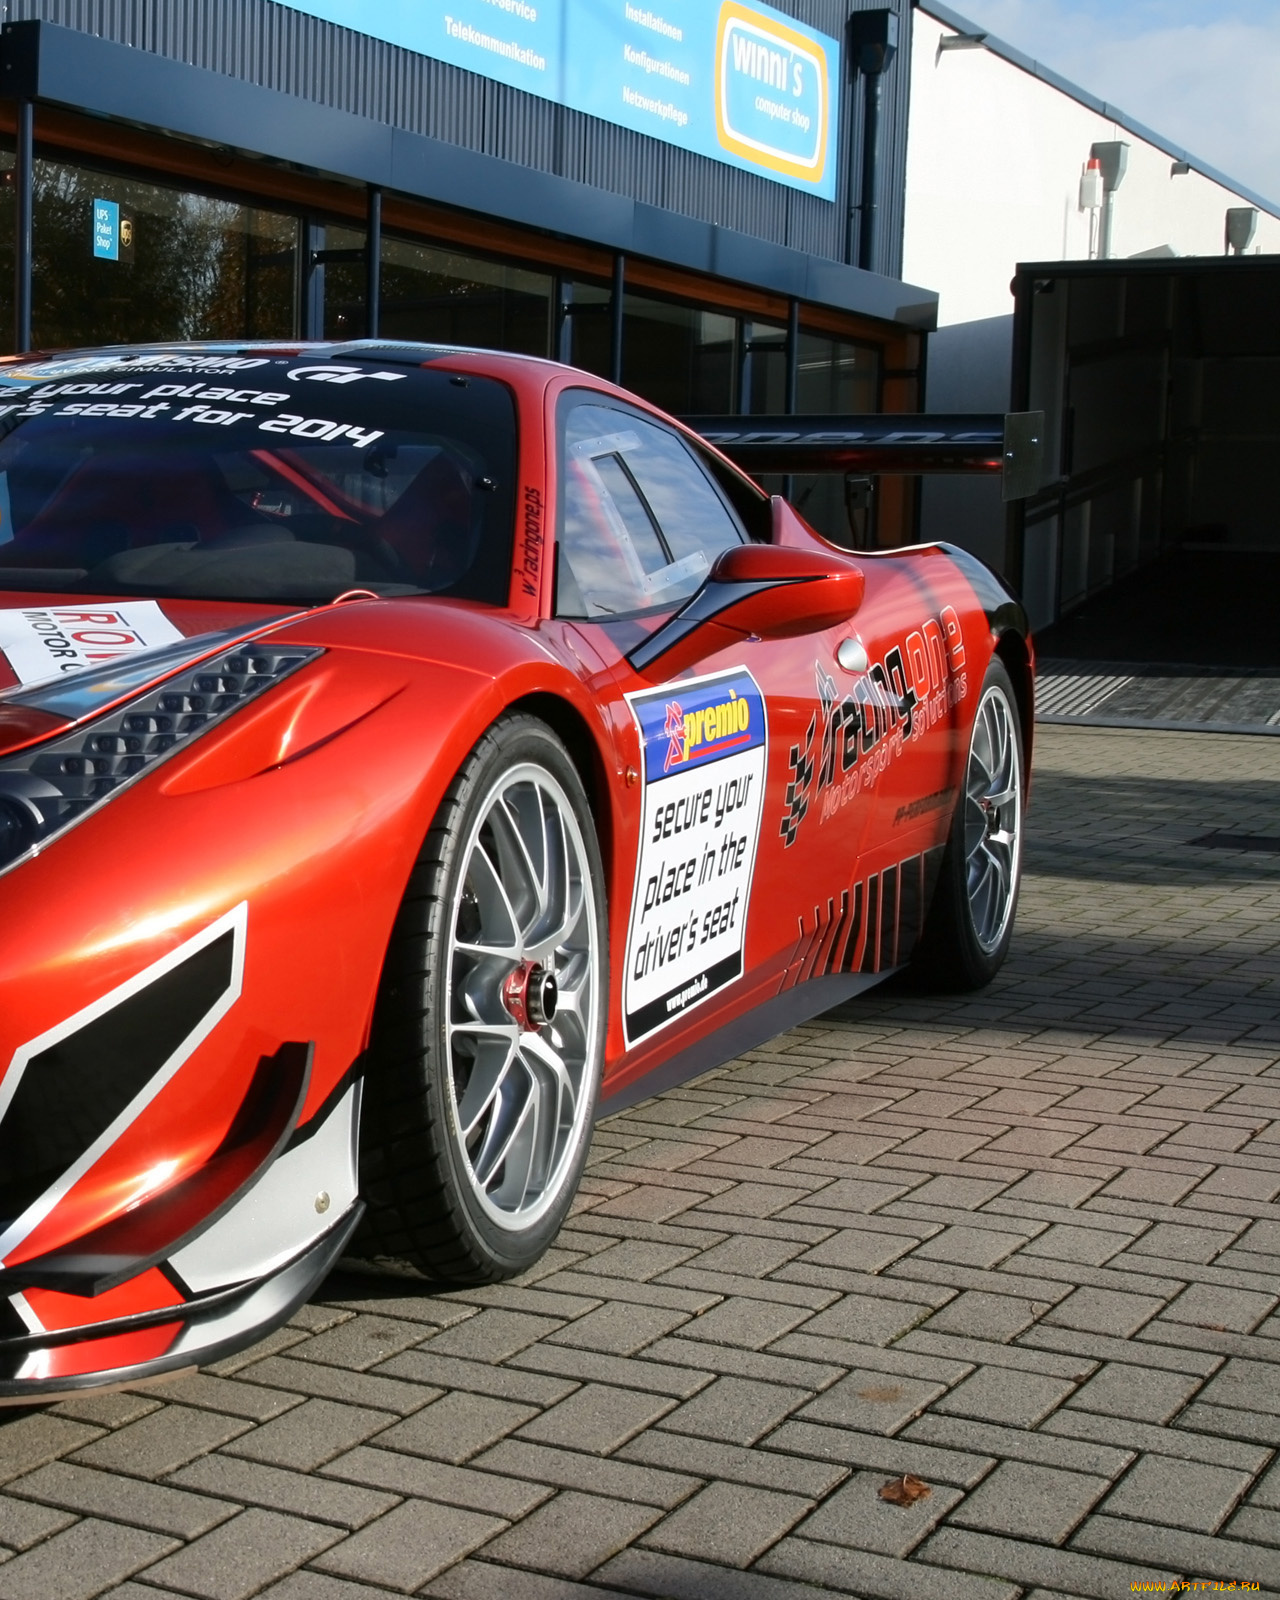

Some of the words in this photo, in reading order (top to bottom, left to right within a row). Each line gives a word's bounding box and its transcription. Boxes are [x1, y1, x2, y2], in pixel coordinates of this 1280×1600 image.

[444, 15, 546, 71] Telekommunikation
[624, 2, 683, 42] Installationen
[623, 44, 690, 86] Konfigurationen
[622, 85, 688, 128] Netzwerkpflege
[754, 95, 791, 122] computer
[791, 107, 810, 134] shop
[96, 208, 109, 221] UPS
[96, 221, 112, 235] Paket
[113, 366, 236, 376] SIMULATOR
[28, 382, 144, 399] your
[138, 382, 291, 406] place
[53, 401, 172, 419] seat
[171, 404, 255, 427] for
[257, 414, 385, 448] 2014
[22, 611, 78, 659] MOTOR
[683, 688, 750, 762] premio
[652, 788, 713, 843] secure
[714, 773, 754, 829] your
[640, 857, 697, 925] place
[697, 841, 716, 887] in
[718, 831, 748, 877] the
[634, 909, 699, 981] driver's
[700, 886, 740, 946] seat
